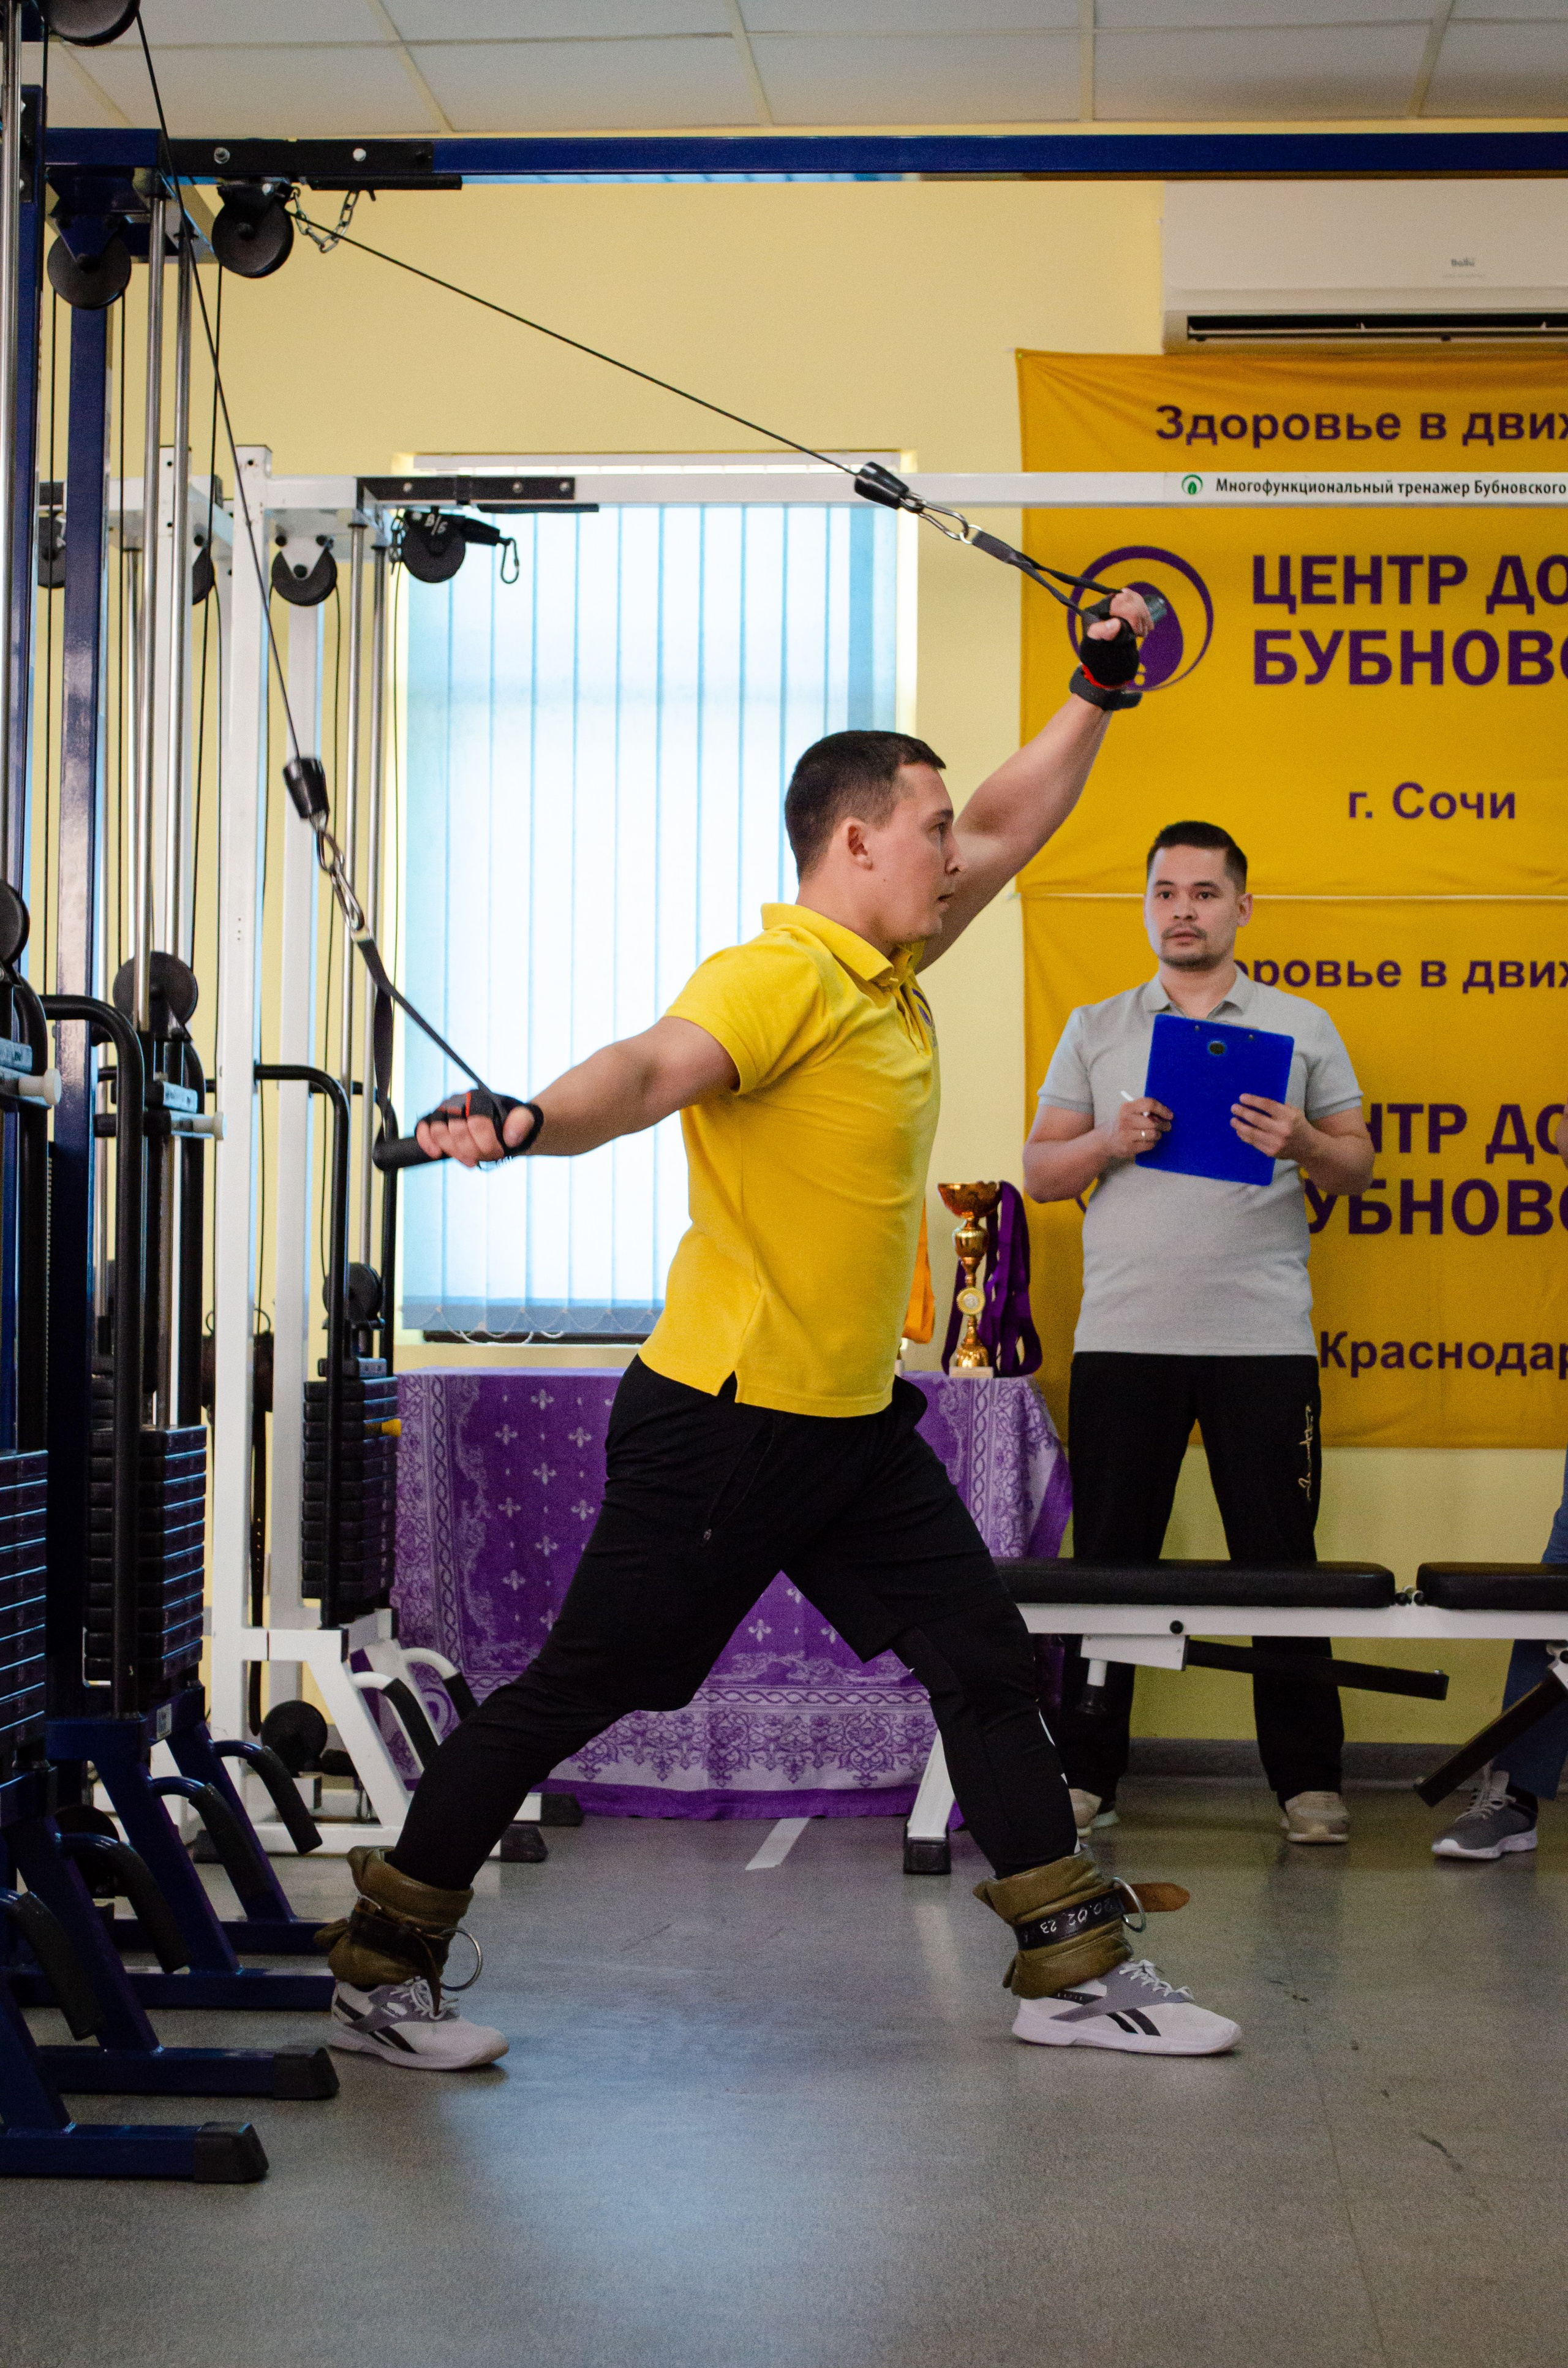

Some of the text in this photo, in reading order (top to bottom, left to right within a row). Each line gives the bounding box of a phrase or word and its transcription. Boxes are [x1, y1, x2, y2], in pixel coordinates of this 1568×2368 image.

[1156, 404, 1568, 448] Здоровье в дви
[1215, 478, 1567, 497] Многофункциональный тренажер Бубновского
[1253, 554, 1468, 615] ЦЕНТР
[1254, 629, 1568, 686] БУБНОВ
[1349, 782, 1516, 820] г. Сочи
[1233, 959, 1568, 994] ровье в дви
[1305, 1178, 1568, 1236] УБНОВ
